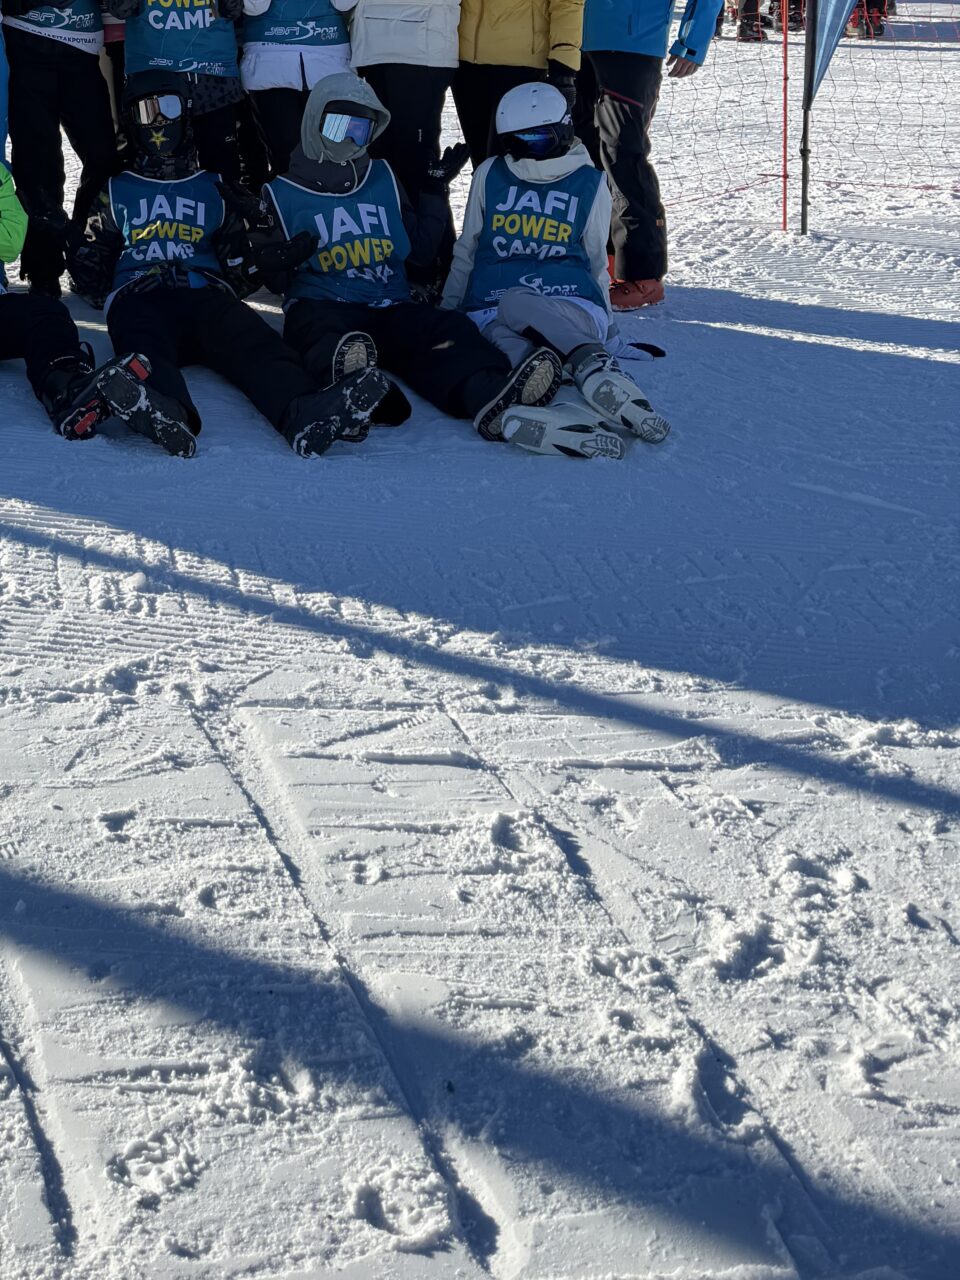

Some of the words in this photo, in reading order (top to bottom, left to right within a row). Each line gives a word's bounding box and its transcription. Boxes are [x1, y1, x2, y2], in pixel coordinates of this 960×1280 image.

[148, 9, 216, 30] CAMP
[131, 194, 206, 226] JAFI
[495, 185, 579, 223] JAFI
[131, 220, 204, 245] POWER
[314, 203, 390, 249] JAFI
[491, 213, 572, 243] POWER
[318, 238, 394, 272] POWER
[492, 236, 567, 260] CAMP
